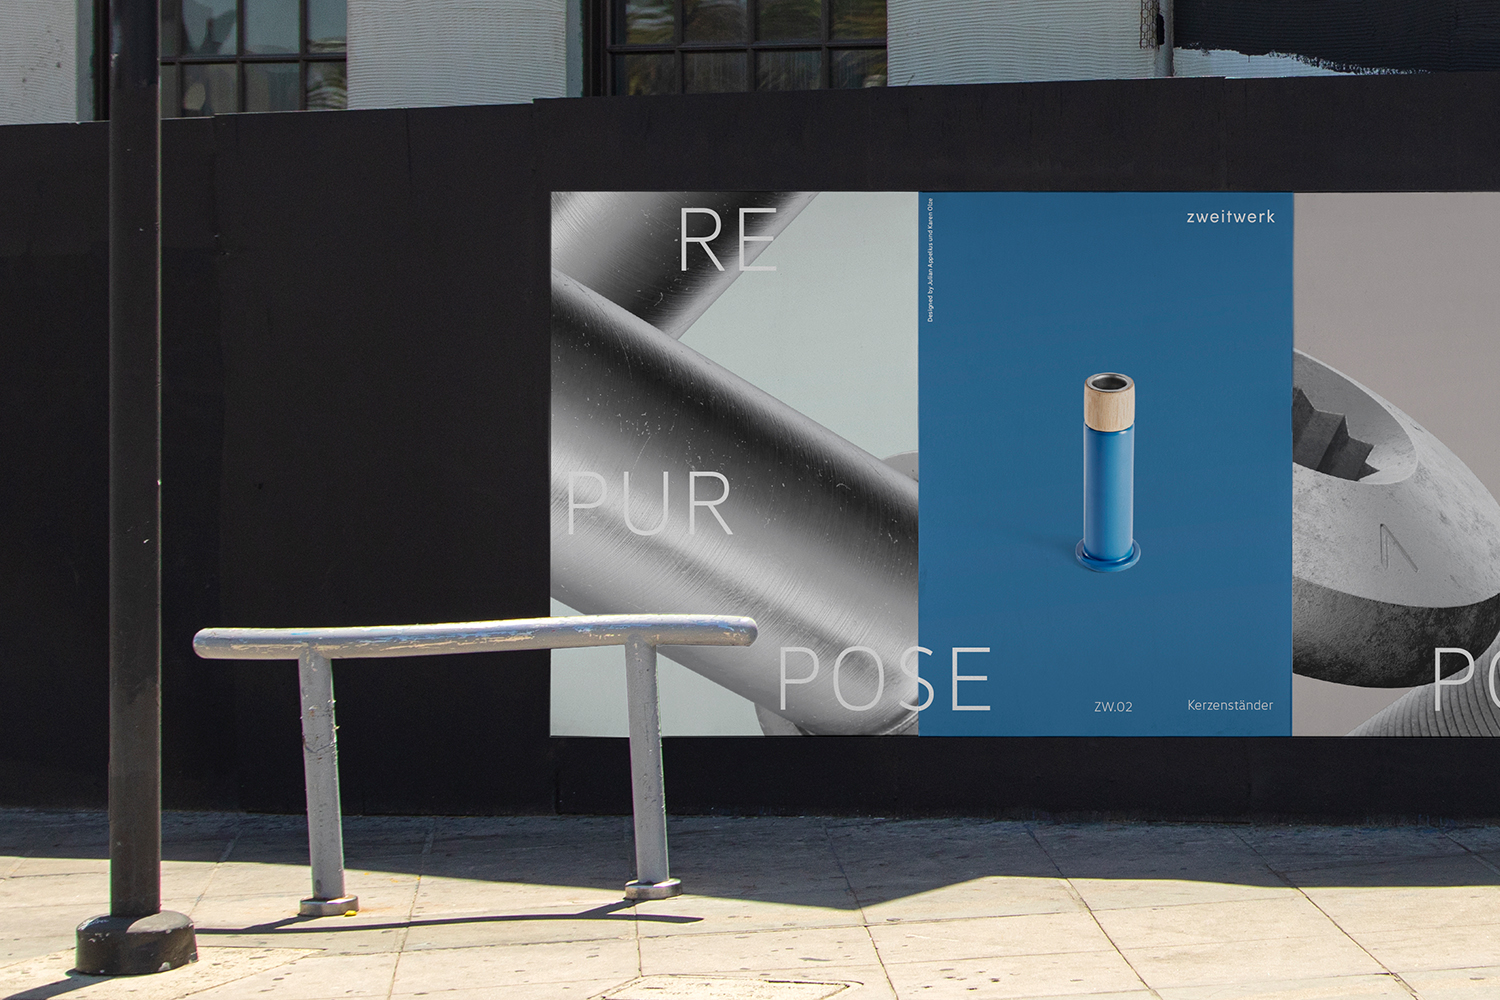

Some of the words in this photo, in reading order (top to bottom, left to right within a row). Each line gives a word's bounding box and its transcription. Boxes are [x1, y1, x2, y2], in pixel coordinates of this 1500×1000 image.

[1186, 209, 1275, 223] zweitwerk
[679, 207, 778, 272] RE
[567, 471, 734, 536] PUR
[780, 646, 992, 712] POSE
[1094, 701, 1133, 713] ZW.02
[1187, 698, 1274, 712] Kerzenständer
